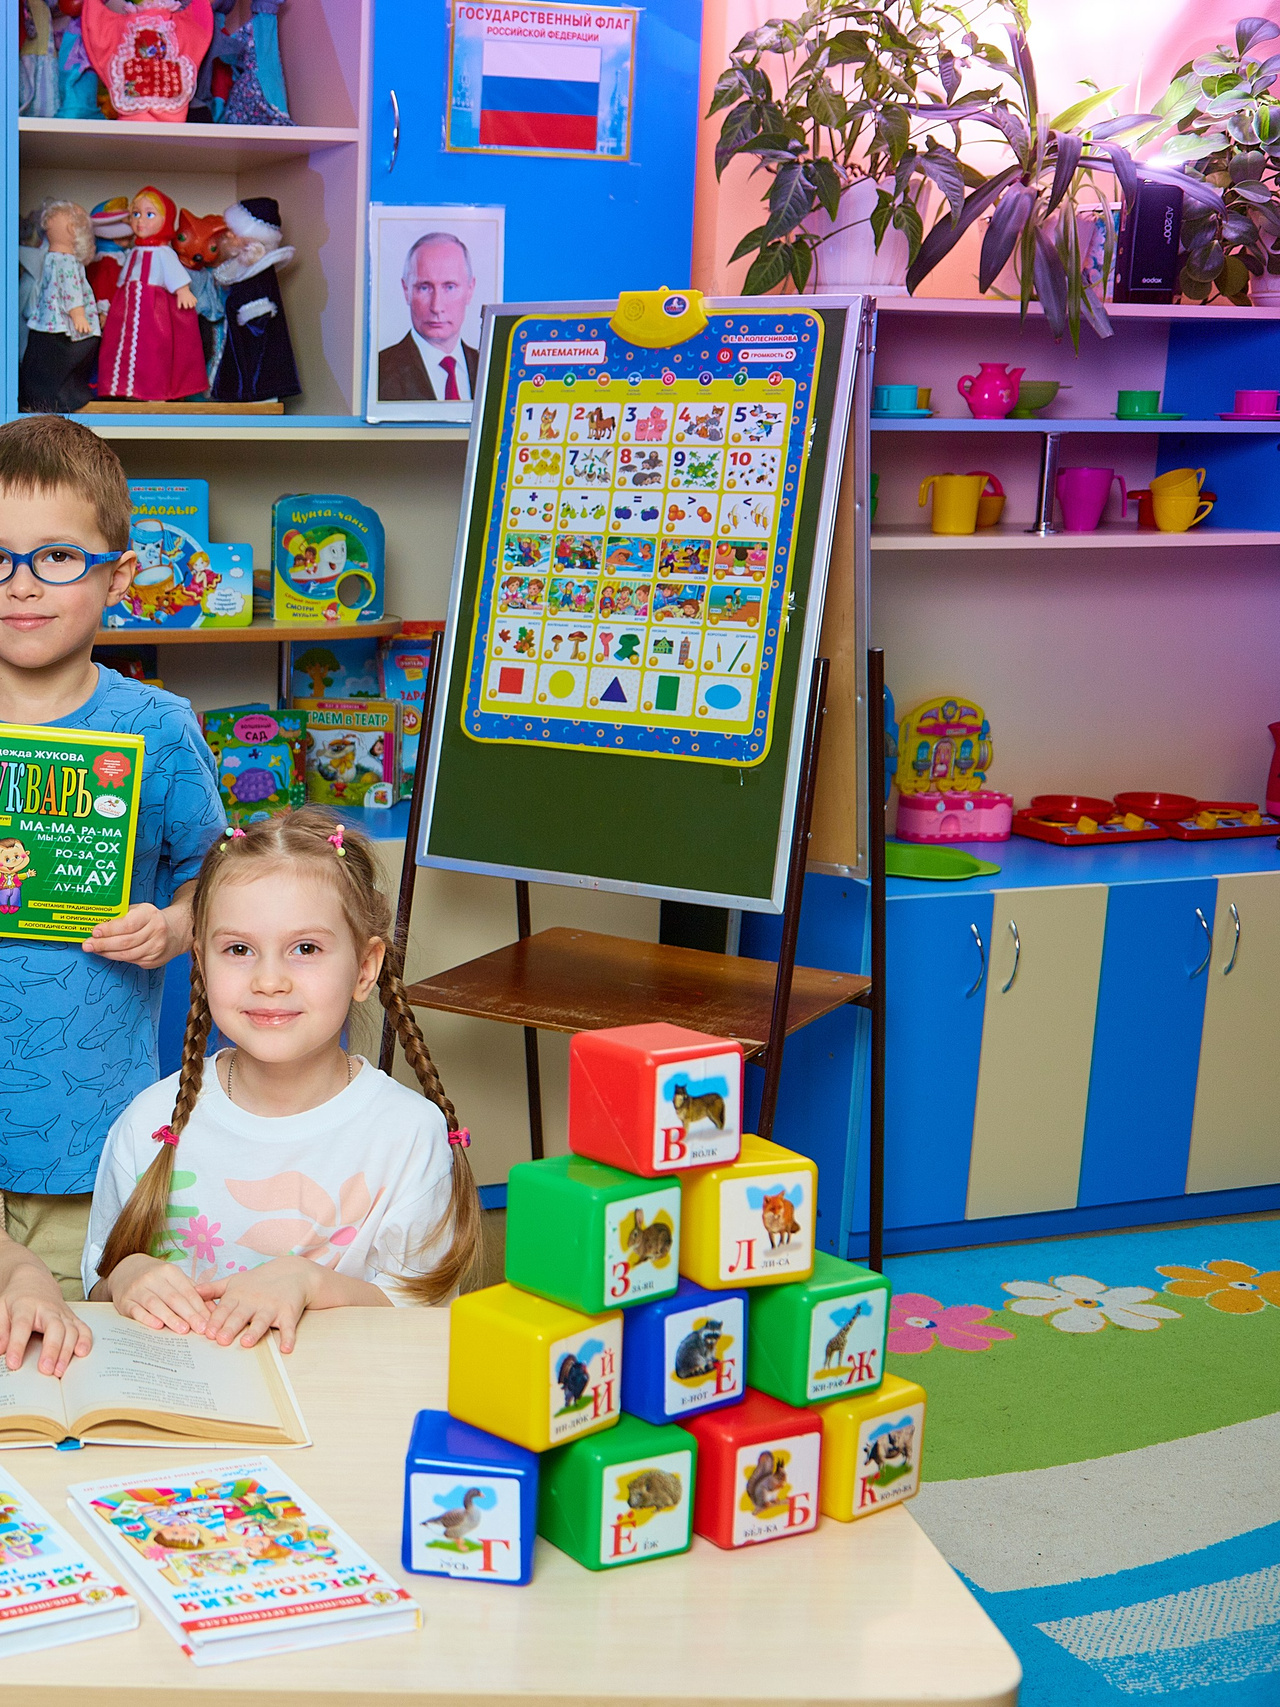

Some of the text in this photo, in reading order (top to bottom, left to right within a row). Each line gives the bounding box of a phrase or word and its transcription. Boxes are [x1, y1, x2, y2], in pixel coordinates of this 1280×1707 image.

[458, 6, 631, 31] ГОСУДАРСТВЕННЫЙ ФЛАГ
[486, 26, 600, 43] РОССИЙСКОЙ ФЕДЕРАЦИИ
[745, 334, 798, 343] КОЛЕСНИКОВА
[531, 347, 600, 358] МАТЕМАТИКА
[525, 407, 534, 420] 1
[573, 407, 585, 420] 2
[625, 407, 637, 422] 3
[678, 407, 691, 422] 4
[734, 406, 747, 422] 5
[518, 448, 530, 463] 6
[569, 450, 580, 465] 7
[620, 448, 632, 464] 8
[673, 451, 686, 466] 9
[729, 452, 752, 466] 10
[131, 503, 198, 515] ОЙДОДЫР
[286, 602, 314, 611] СМОТРИ
[354, 713, 389, 727] ТЕАТР
[245, 731, 268, 742] САД
[34, 750, 85, 763] ЖУКОВА
[20, 820, 122, 838] МА-МА РА-МА
[38, 833, 93, 845] МЫ-ЛО УС
[56, 849, 94, 861] РО-ЗА
[95, 842, 120, 854] ОХ
[54, 864, 82, 877] АМ
[95, 859, 116, 870] СА
[85, 871, 117, 887] АУ
[54, 884, 93, 894] ЛУ-НА
[33, 901, 113, 912] СОЧЕТАНИЕ ТРАДИЦИОННОЙ
[24, 922, 77, 931] ЛОГОПЕДИЧЕСКОЙ
[660, 1127, 688, 1163] В
[692, 1148, 718, 1159] ВОЛК
[728, 1238, 757, 1272] Л
[762, 1257, 790, 1269] ЛИ-СА
[611, 1261, 631, 1298] З
[600, 1347, 615, 1379] Й
[845, 1349, 877, 1385] Ж
[712, 1358, 737, 1397] Е
[590, 1378, 615, 1420] И
[681, 1390, 708, 1405] Е-НОТ
[555, 1414, 589, 1435] ИН-ДЮК
[858, 1471, 881, 1510] К
[784, 1492, 810, 1528] Б
[609, 1511, 638, 1558] Ё
[643, 1538, 659, 1551] ЁЖ
[478, 1538, 510, 1573] Г
[251, 1571, 328, 1590] СРЕДНЕЙ
[179, 1572, 383, 1613] ХРЕСТОМАТИЯ
